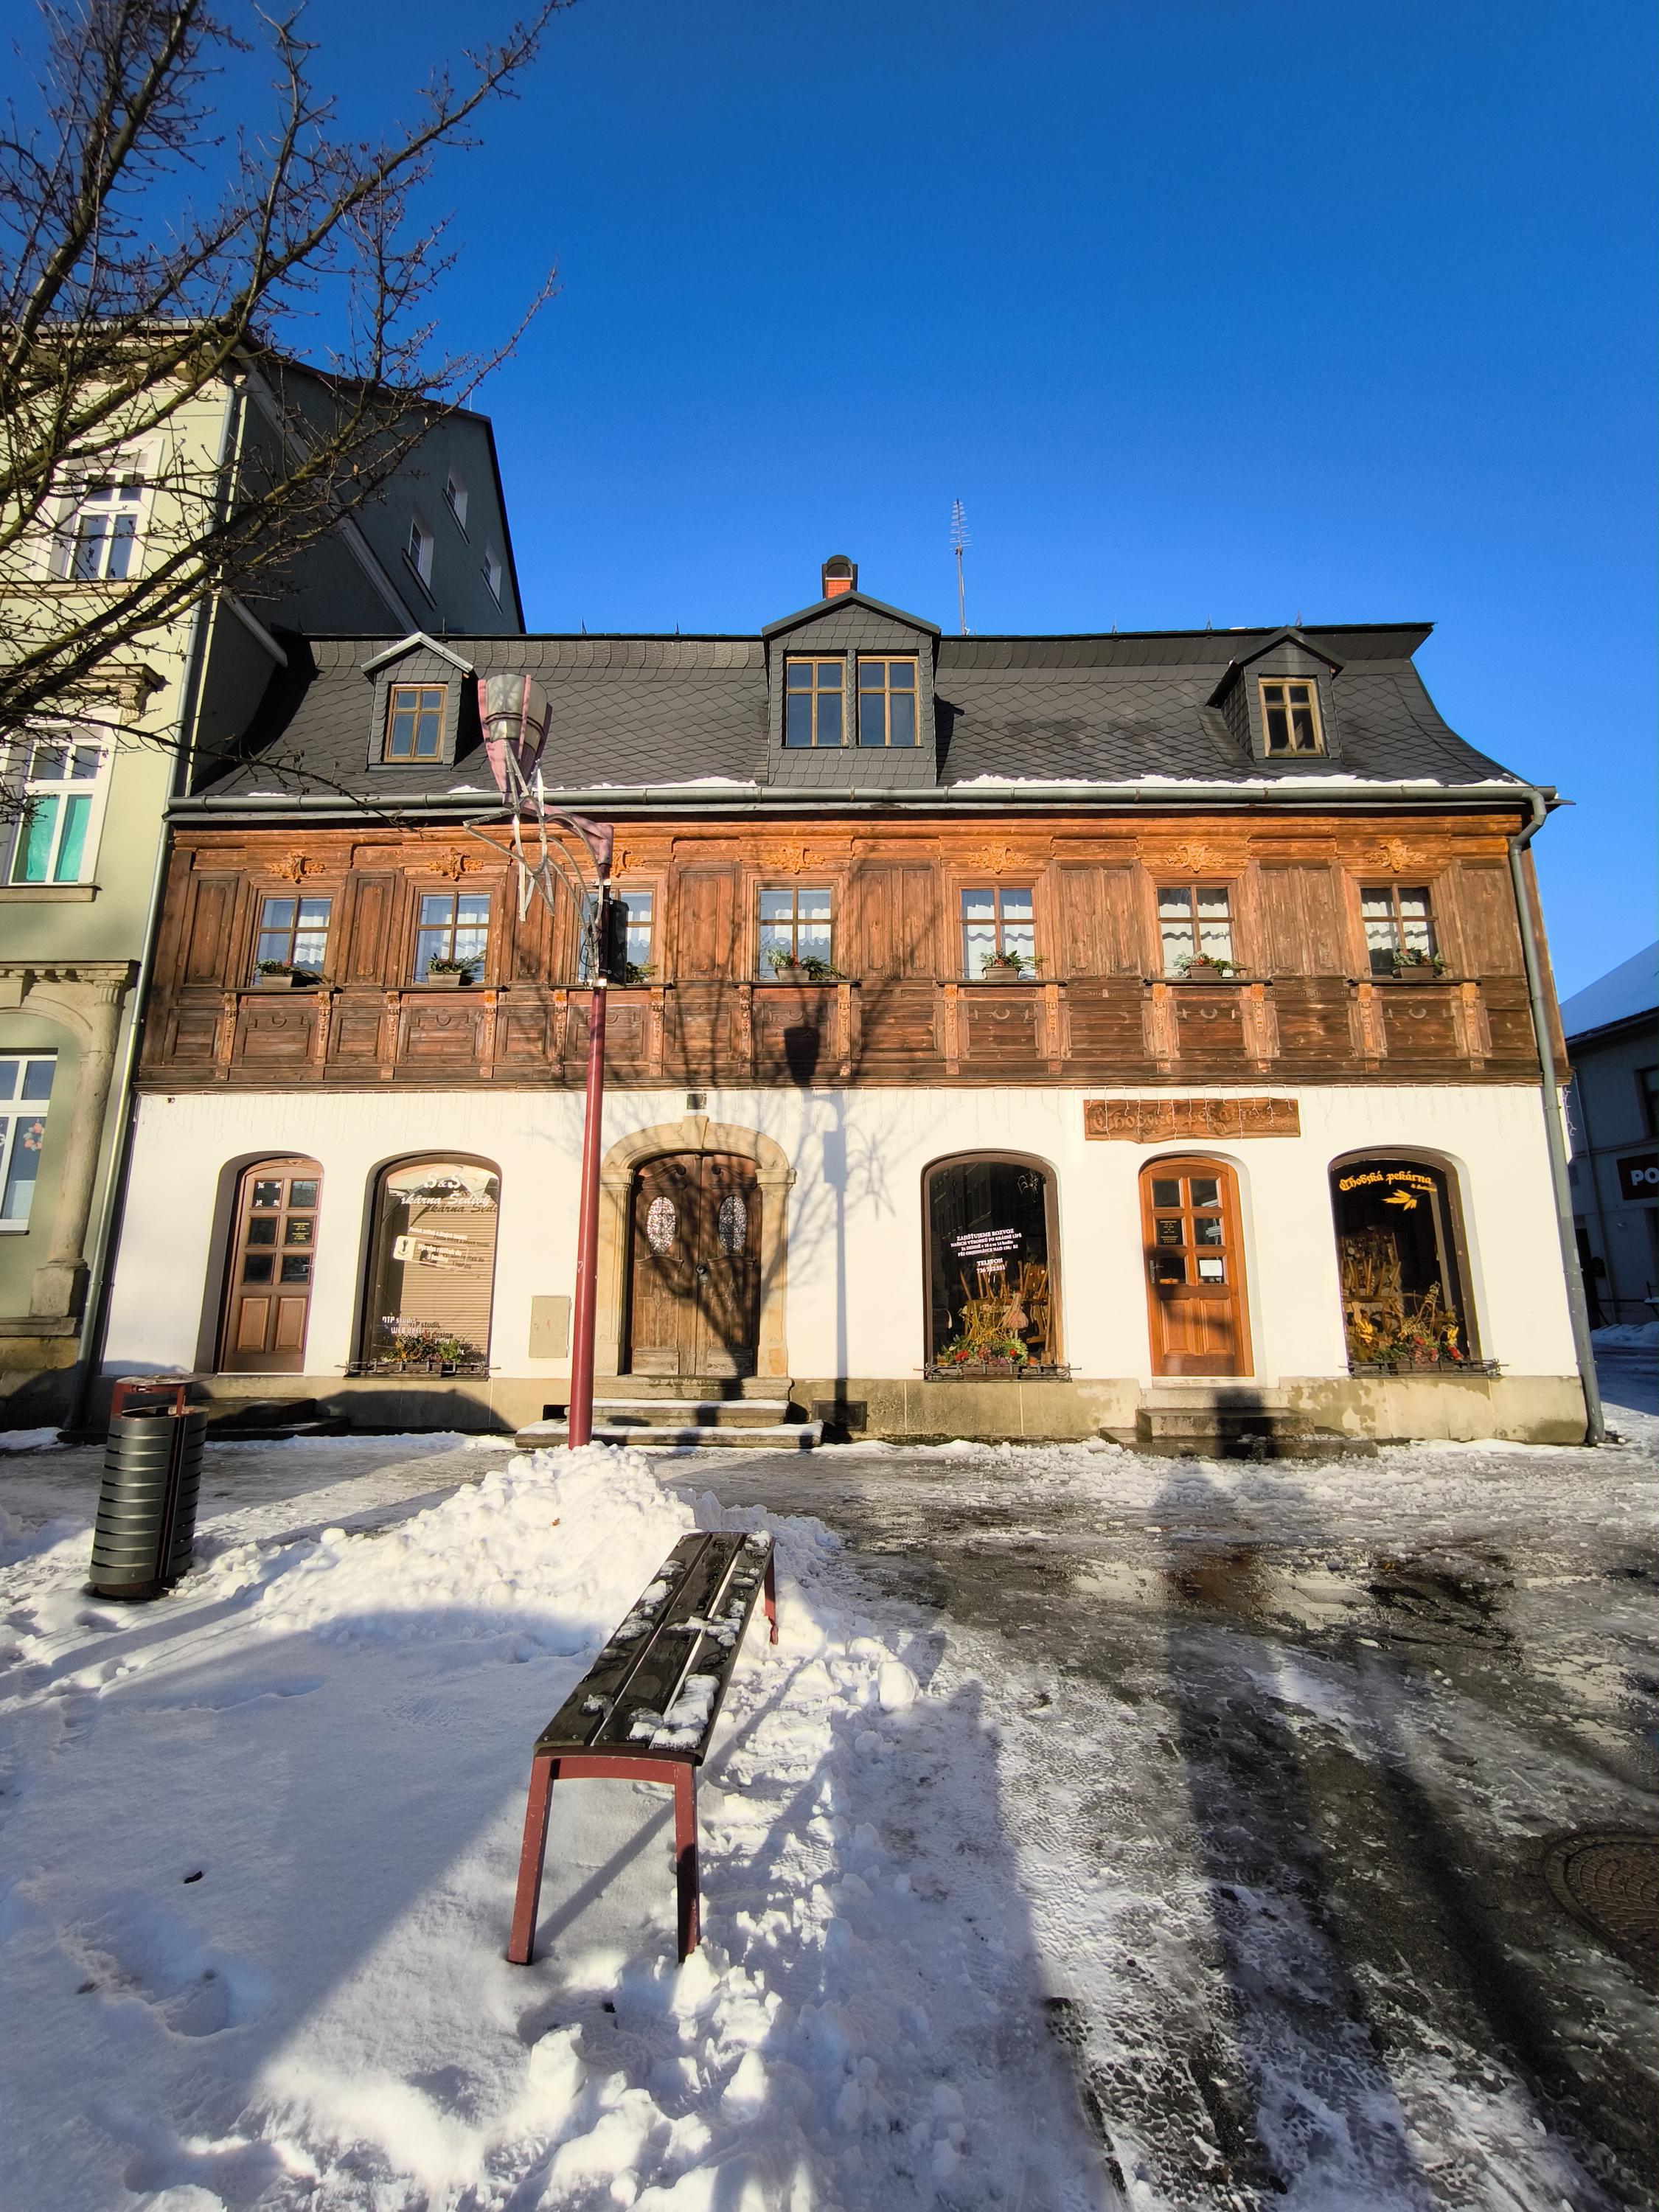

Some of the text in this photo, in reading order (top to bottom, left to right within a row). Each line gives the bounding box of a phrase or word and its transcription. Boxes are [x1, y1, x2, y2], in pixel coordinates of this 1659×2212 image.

[1339, 1170, 1433, 1191] Chodská pekárna
[956, 1231, 991, 1241] ZAJIŠŤUJEME
[976, 1258, 1003, 1266] TELEFON
